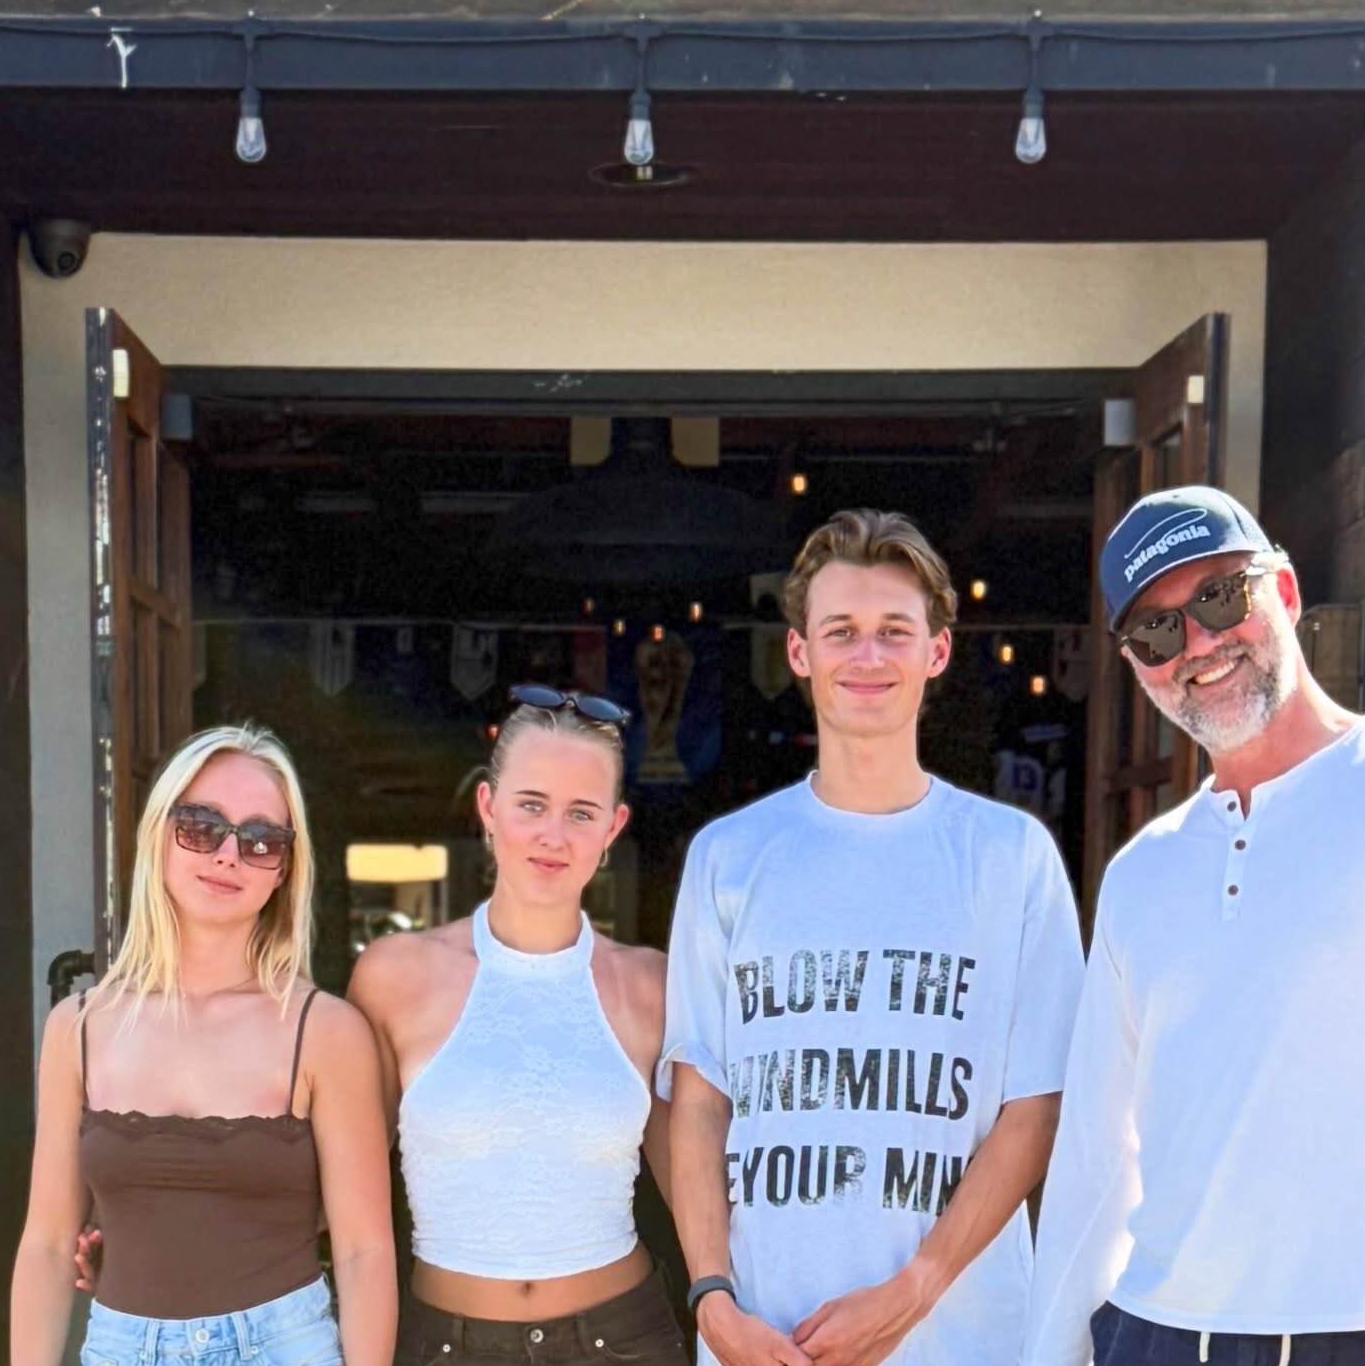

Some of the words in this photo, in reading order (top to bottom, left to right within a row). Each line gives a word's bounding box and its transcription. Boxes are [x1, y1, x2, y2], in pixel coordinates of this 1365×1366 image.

[1124, 524, 1211, 582] patagonia
[734, 949, 870, 1025] BLOW
[882, 949, 976, 1020] THE
[882, 1147, 974, 1217] MIN
